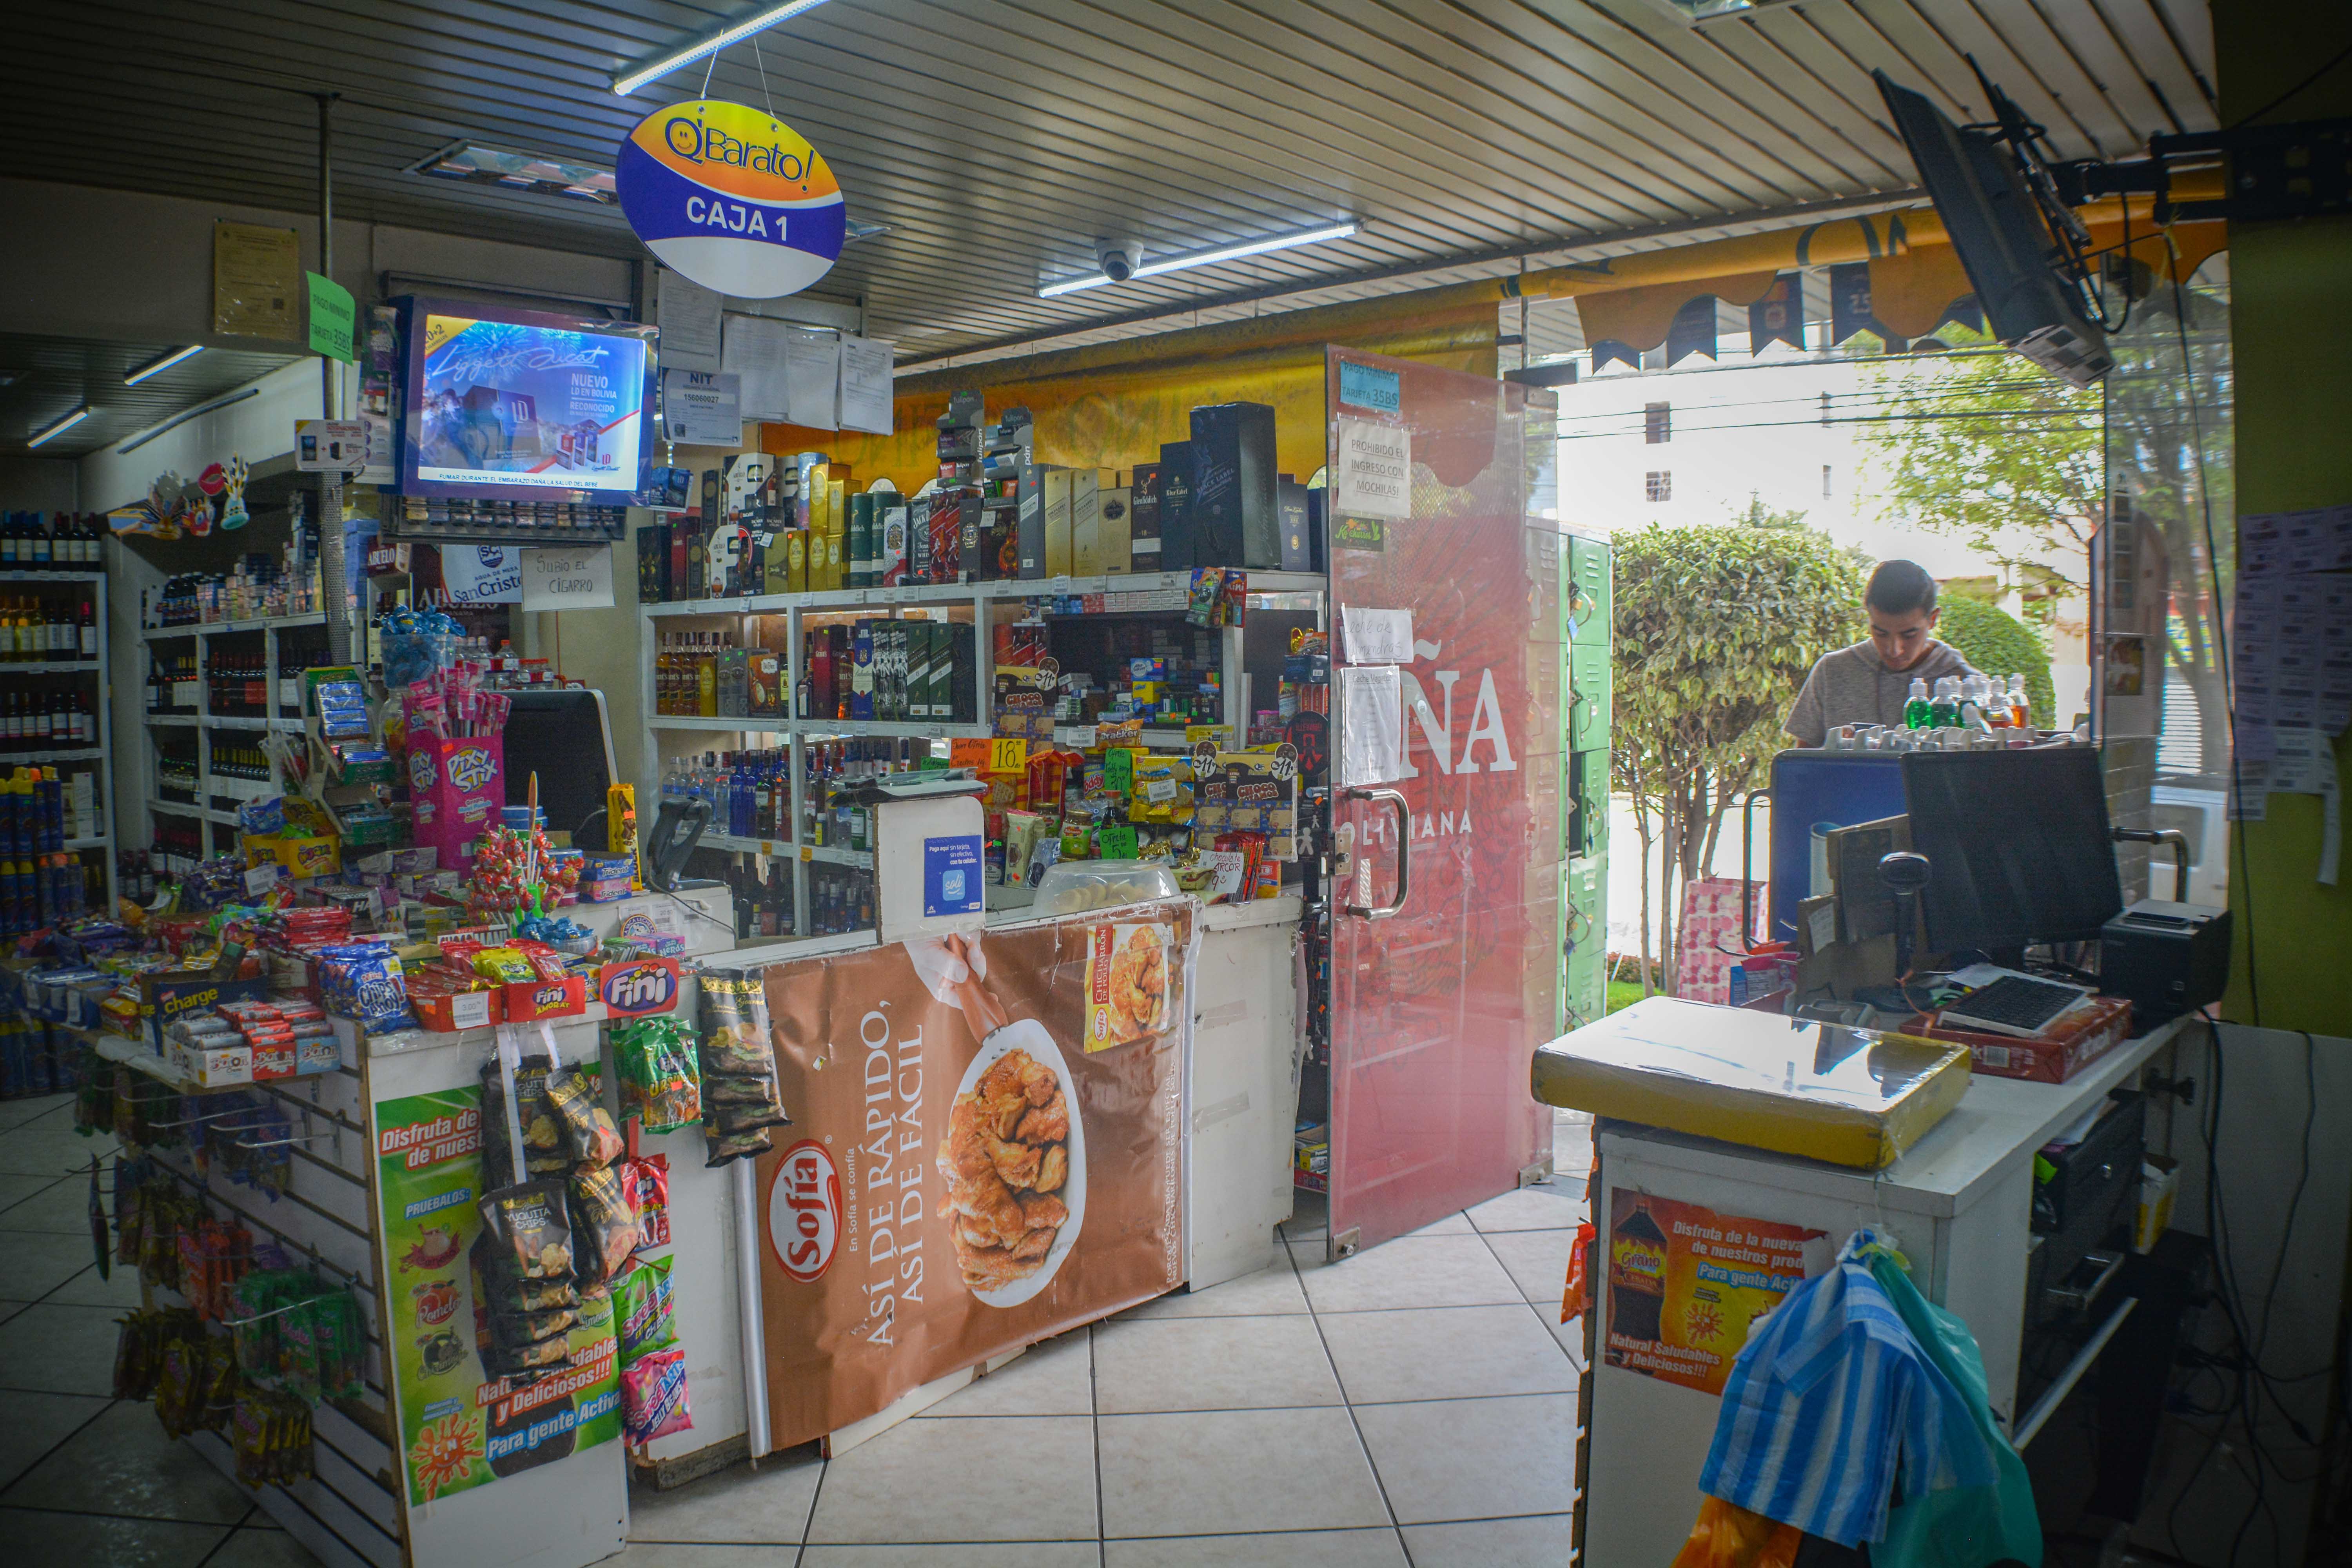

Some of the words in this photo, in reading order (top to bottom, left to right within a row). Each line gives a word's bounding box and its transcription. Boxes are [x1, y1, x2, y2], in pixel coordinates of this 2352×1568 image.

[686, 196, 768, 238] CAJA
[775, 216, 787, 241] 1
[313, 295, 328, 310] PAGO
[334, 329, 350, 351] 35BS
[432, 344, 527, 382] Liggett
[1344, 363, 1364, 375] PAGO
[1366, 367, 1394, 381] MINIMO
[572, 373, 608, 388] NUEVO
[690, 373, 713, 384] NIT
[592, 390, 617, 399] BOLIVIA
[684, 394, 719, 403] 156060027
[1342, 387, 1371, 400] TARJETA
[1372, 388, 1397, 405] 35BS
[512, 400, 528, 423] LD
[570, 401, 615, 413] RECONOCIDO
[603, 454, 610, 465] LD
[1351, 440, 1394, 456] PROHIBIDO
[1396, 448, 1403, 457] EL
[1351, 460, 1385, 474] INGRESO
[1388, 466, 1403, 477] CON
[1357, 481, 1399, 495] MOCHILAS!
[1133, 495, 1157, 505] Glenfiddich
[368, 548, 395, 565] ABUELO
[575, 561, 588, 570] EL
[1377, 616, 1391, 633] de
[993, 740, 1016, 768] 18
[602, 867, 628, 877] Trident
[1214, 862, 1240, 872] ARCOR
[600, 889, 626, 898] Trident
[945, 874, 962, 891] soli
[359, 982, 393, 1007] Chips
[536, 986, 563, 1004] Fini
[611, 967, 666, 1007] Fini
[1102, 989, 1107, 1000] DE
[165, 989, 218, 1013] charge
[1096, 1012, 1105, 1038] Sofía
[858, 1000, 893, 1193] RÁPIDO,
[891, 1024, 922, 1156] FÁCIL
[382, 1117, 451, 1152] Disfruta
[457, 1110, 477, 1131] de
[1171, 1132, 1176, 1145] DE
[409, 1147, 430, 1167] de
[845, 1148, 855, 1184] confía
[406, 1188, 469, 1218] PRUEBALOS:
[849, 1189, 856, 1201] se
[900, 1163, 923, 1230] DE
[505, 1208, 551, 1222] YUQUITA
[515, 1218, 546, 1229] CHIPS
[786, 1157, 822, 1271] Sofía
[847, 1204, 857, 1234] Sofía
[869, 1201, 894, 1268] DE
[1673, 1221, 1721, 1242] Disfruta
[1727, 1230, 1742, 1244] de
[1747, 1233, 1758, 1245] la
[849, 1237, 858, 1252] En
[1692, 1241, 1708, 1254] de
[1711, 1245, 1768, 1264] nuestros
[893, 1236, 923, 1305] ASÍ
[1699, 1264, 1728, 1281] Para
[1731, 1271, 1768, 1289] gente
[416, 1299, 461, 1328] Pomelo
[862, 1274, 895, 1348] ASÍ
[1610, 1335, 1652, 1352] Natural
[1655, 1341, 1720, 1365] Saludables
[1621, 1354, 1630, 1365] y
[1633, 1354, 1707, 1377] Deliciosos!!!
[499, 1401, 510, 1423] y
[513, 1361, 611, 1412] Deliciosos!!!
[650, 1405, 666, 1433] JELLY
[665, 1383, 682, 1413] BEANS
[488, 1430, 524, 1459] Para
[528, 1410, 575, 1447] gente
